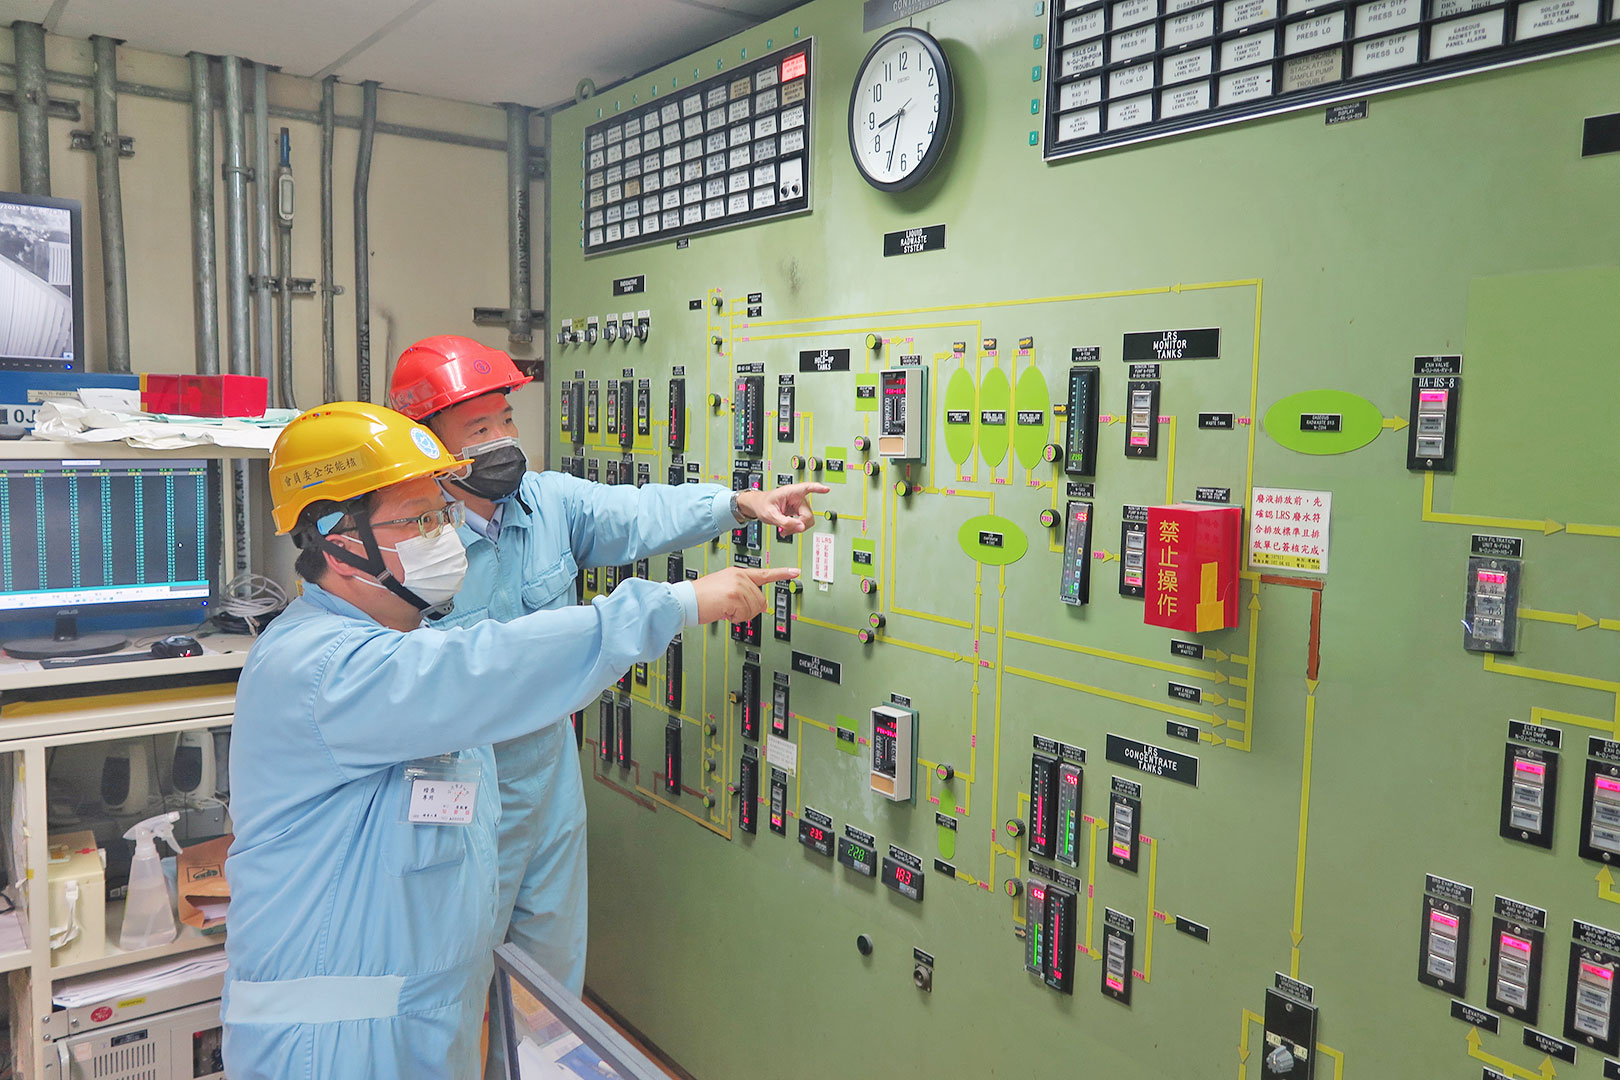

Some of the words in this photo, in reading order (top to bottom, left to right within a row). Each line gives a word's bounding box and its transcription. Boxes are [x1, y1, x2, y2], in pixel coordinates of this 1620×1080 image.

[1123, 7, 1139, 17] PRESS
[1540, 4, 1559, 14] SOLID
[1561, 1, 1574, 9] RAD
[1086, 14, 1096, 22] DIFF
[1192, 12, 1204, 20] DIFF
[1369, 13, 1392, 22] PRESS
[1544, 9, 1569, 20] SYSTEM
[1316, 18, 1331, 27] DIFF
[1534, 20, 1553, 29] PANEL
[1556, 14, 1579, 24] ALARM
[1136, 28, 1148, 37] DIFF
[1296, 31, 1318, 40] PRESS
[1121, 40, 1138, 49] PRESS
[1389, 36, 1406, 45] DIFF
[1446, 40, 1464, 48] PANEL
[1467, 35, 1486, 44] ALARM
[1366, 50, 1390, 60] PRESS
[1395, 46, 1404, 54] LO
[899, 51, 908, 71] 12
[919, 53, 922, 71] 1
[1072, 61, 1095, 71] TROUBLE
[1288, 56, 1309, 66] WASTE
[885, 62, 892, 82] 11
[1289, 72, 1313, 82] SAMPLE
[1315, 66, 1333, 75] PUMP
[1291, 64, 1310, 74] STACK
[928, 67, 934, 86] 2
[1297, 77, 1325, 88] TROUBLE
[873, 83, 882, 102] 10
[934, 93, 939, 113] 3
[869, 112, 875, 130] 9
[928, 120, 935, 135] 4
[875, 134, 881, 152] 8
[886, 150, 891, 169] 7
[918, 143, 924, 163] 5
[901, 154, 907, 171] 6
[900, 235, 927, 247] RADWASTE
[904, 243, 924, 253] SYSTEM
[1163, 332, 1177, 341] LRS
[1153, 340, 1187, 350] MONITOR
[1157, 350, 1182, 359] TANKS
[1157, 520, 1179, 616] 禁止操作
[1144, 745, 1158, 756] LRS
[1124, 748, 1178, 771] CONCENTRATE
[1137, 760, 1162, 776] TANKS
[810, 827, 823, 841] 235
[848, 844, 865, 862] 228
[896, 867, 912, 885] 183
[1512, 901, 1525, 910] EVAP
[1526, 906, 1539, 914] ROOM
[1590, 926, 1605, 935] PUMP
[1462, 1007, 1487, 1022] ELEVATION
[1536, 1036, 1563, 1051] ELEVATION
